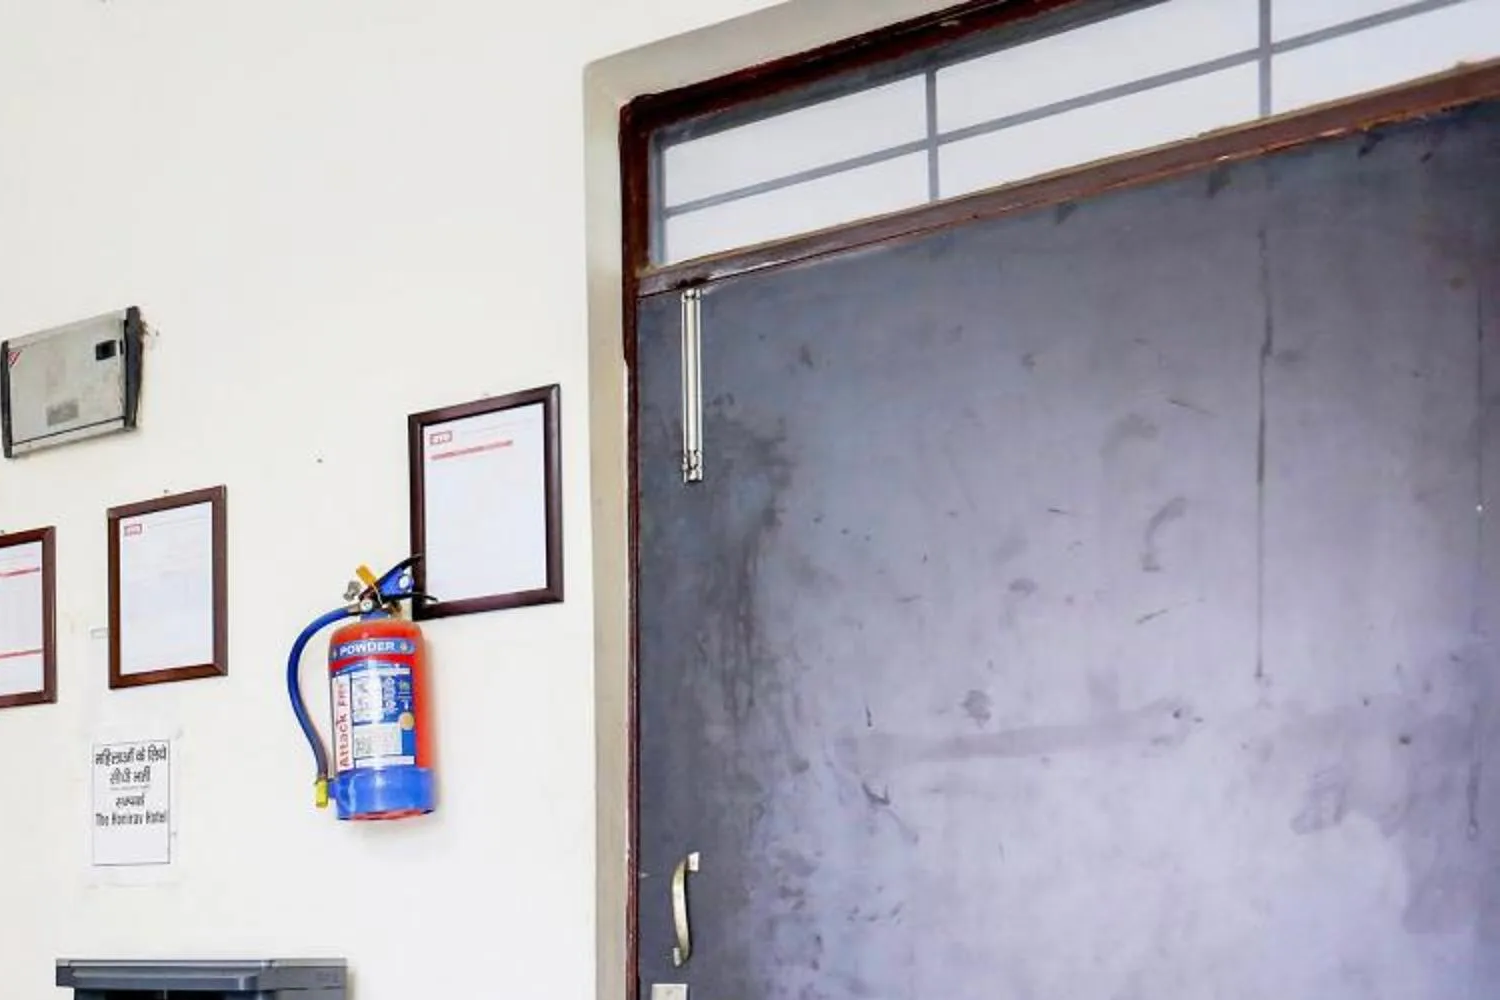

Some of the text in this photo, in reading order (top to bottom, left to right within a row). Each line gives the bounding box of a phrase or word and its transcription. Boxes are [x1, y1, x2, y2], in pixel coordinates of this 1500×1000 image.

[339, 640, 396, 657] POWDER
[338, 713, 349, 768] Attack
[95, 812, 109, 826] The
